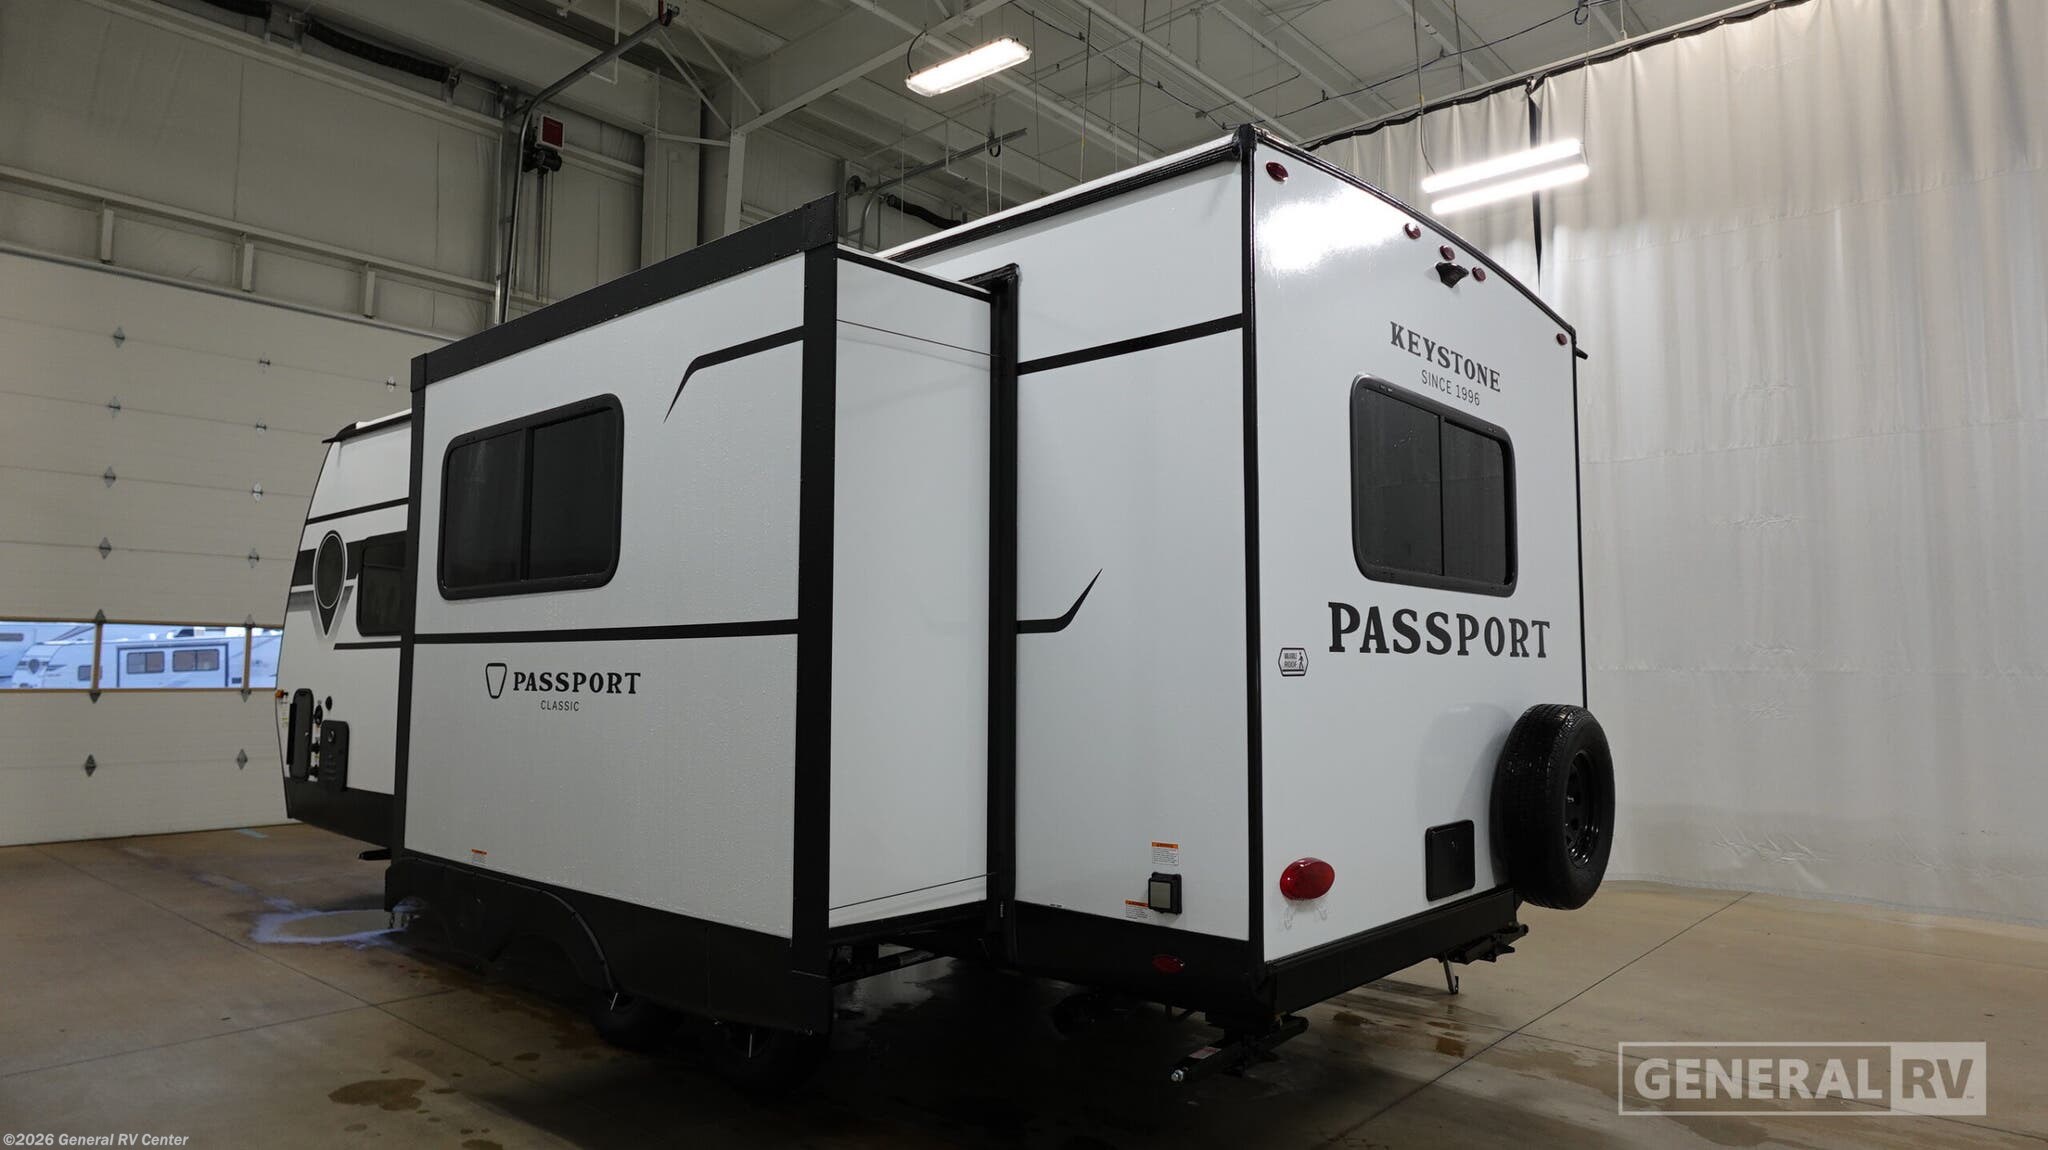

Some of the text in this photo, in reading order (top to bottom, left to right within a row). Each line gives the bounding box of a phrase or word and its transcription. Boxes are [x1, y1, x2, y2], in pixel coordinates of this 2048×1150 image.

[1390, 321, 1501, 393] KEYSTONE
[1421, 369, 1480, 406] SINCE 1996
[1327, 601, 1551, 658] PASSPORT
[512, 671, 641, 695] PASSPORT
[540, 699, 580, 712] CLASSIC
